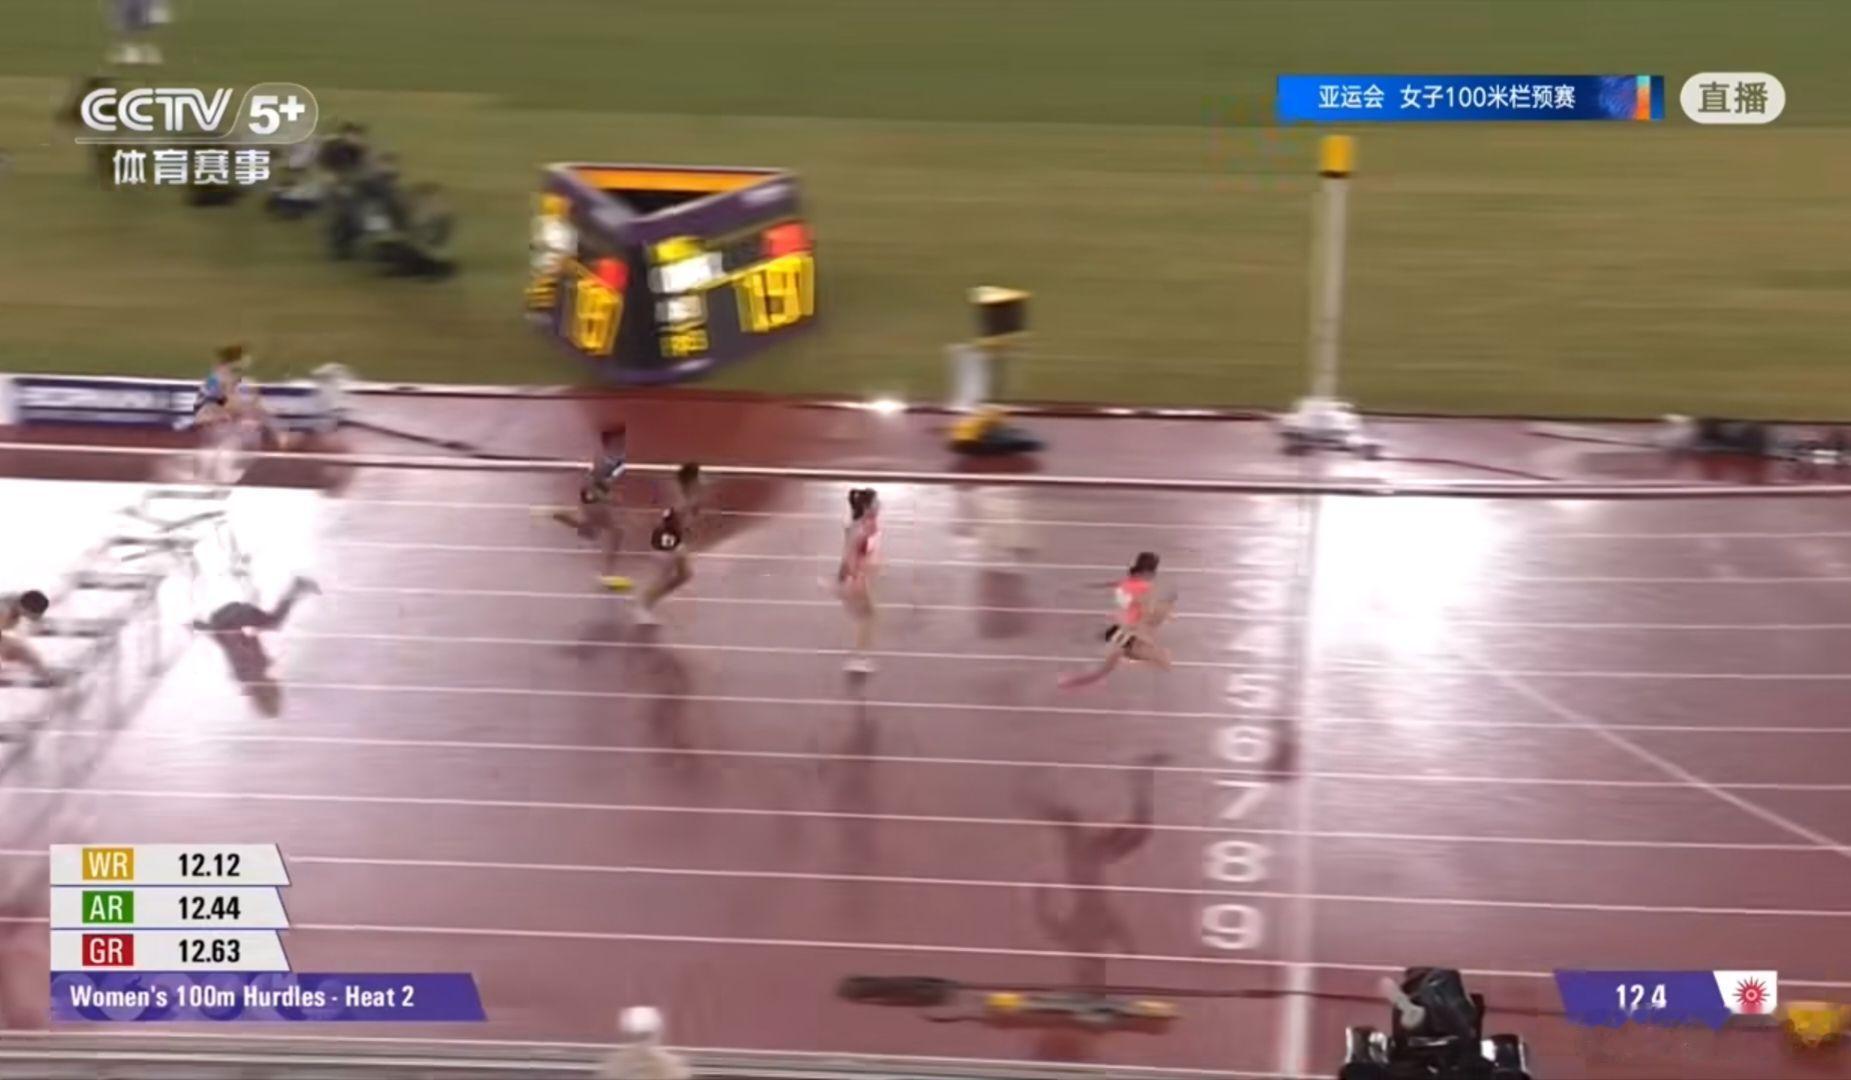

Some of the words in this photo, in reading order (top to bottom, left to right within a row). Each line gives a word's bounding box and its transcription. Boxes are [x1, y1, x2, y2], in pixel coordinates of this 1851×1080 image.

[1225, 673, 1280, 709] 5
[1216, 726, 1273, 763] 6
[1212, 779, 1273, 820] 7
[1204, 840, 1270, 882] 8
[1200, 903, 1263, 949] 9
